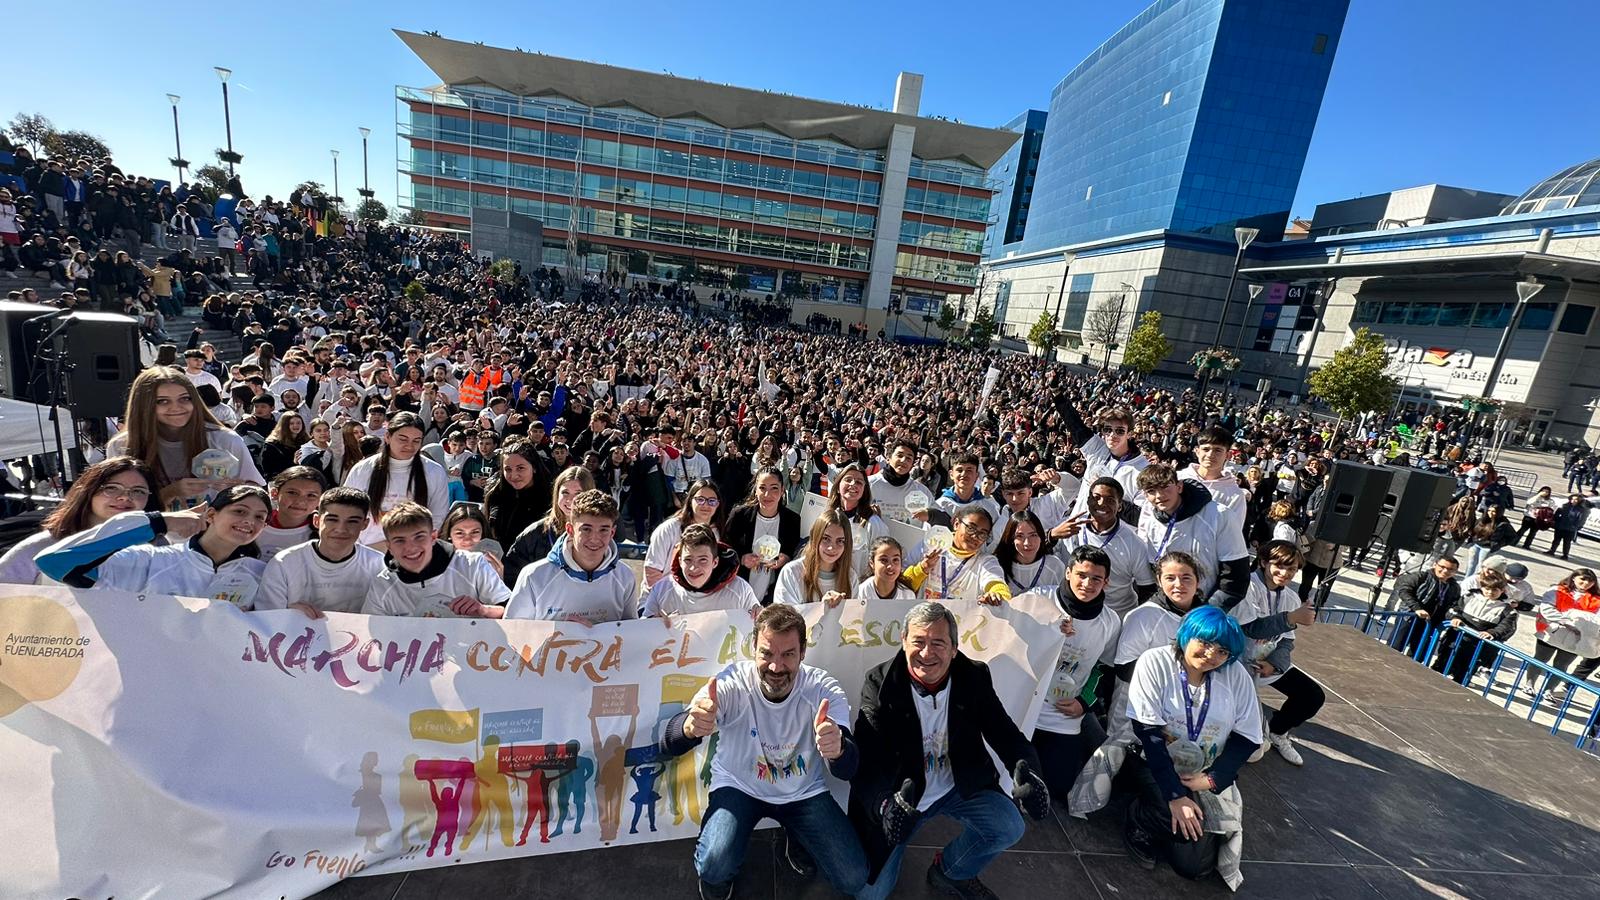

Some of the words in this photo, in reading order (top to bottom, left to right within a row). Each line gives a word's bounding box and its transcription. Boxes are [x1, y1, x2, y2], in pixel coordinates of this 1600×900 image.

[5, 633, 74, 647] Ayuntamiento
[75, 635, 91, 646] de
[4, 645, 85, 658] FUENLABRADA
[241, 627, 447, 688] MARCHA
[465, 631, 624, 683] CONTRA
[648, 632, 709, 669] EL
[717, 624, 824, 664] ACO
